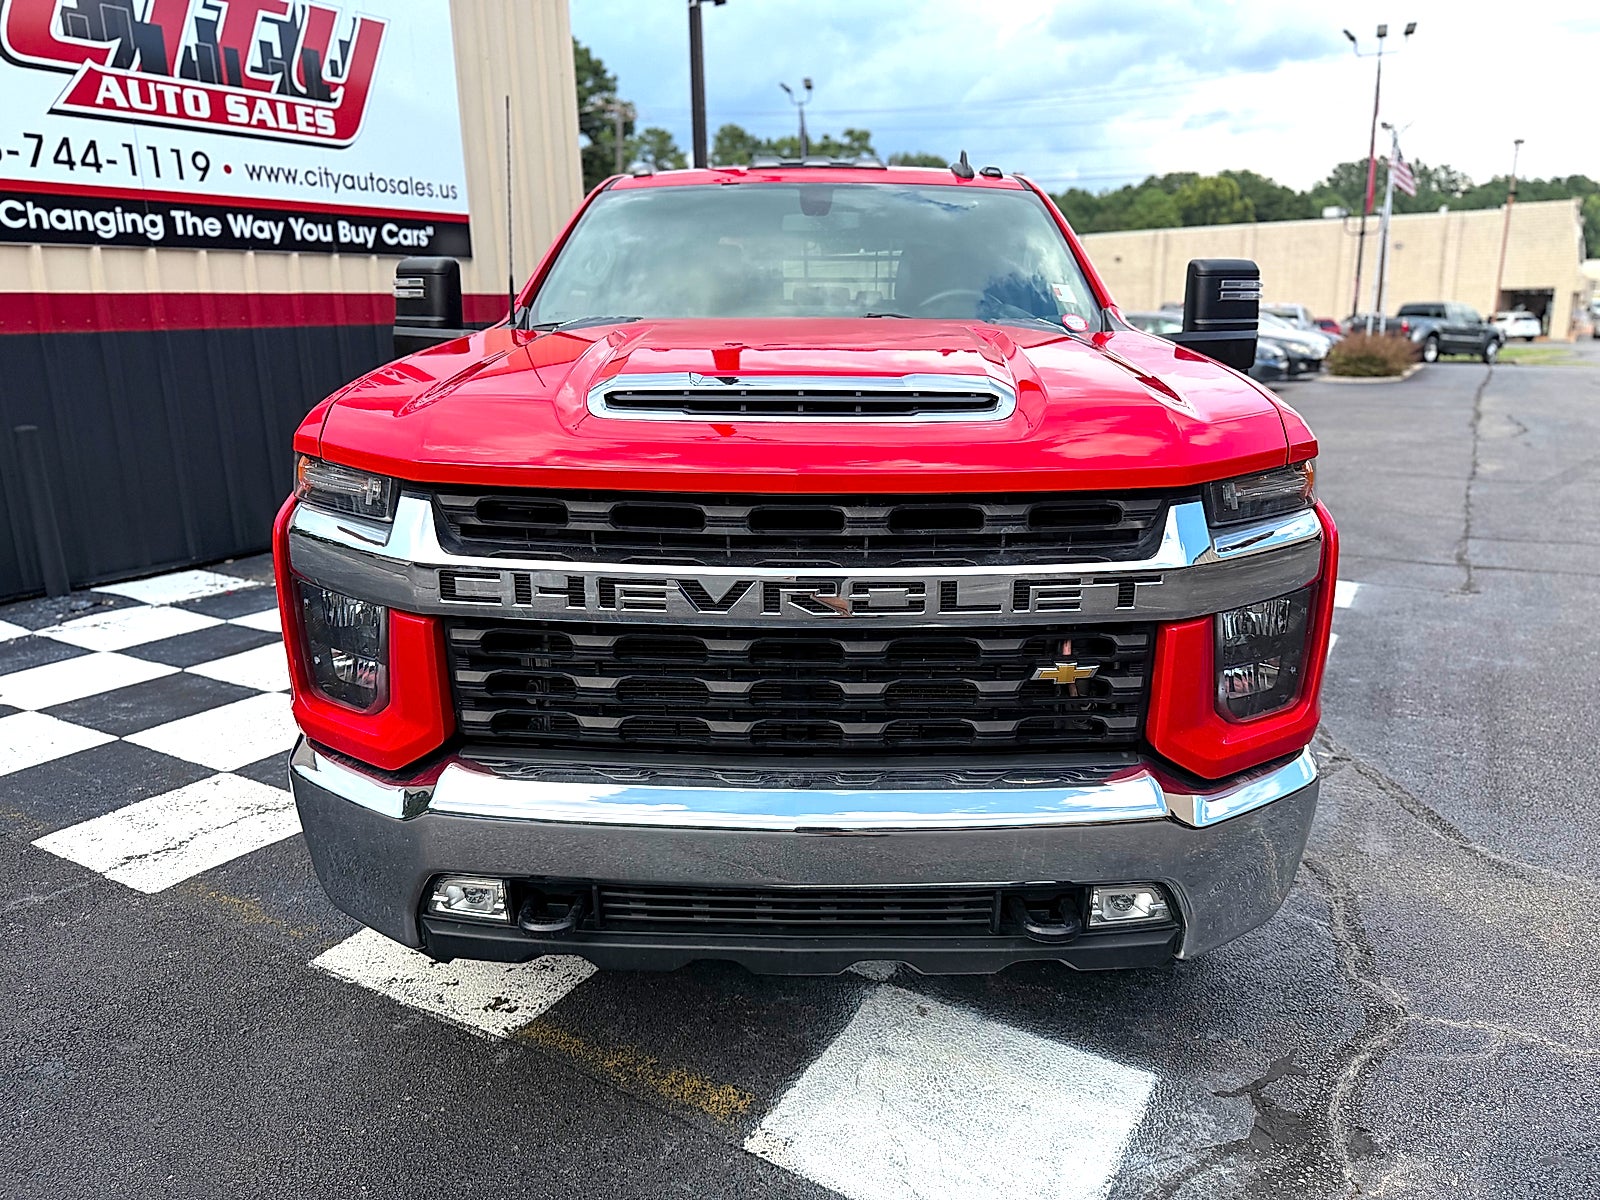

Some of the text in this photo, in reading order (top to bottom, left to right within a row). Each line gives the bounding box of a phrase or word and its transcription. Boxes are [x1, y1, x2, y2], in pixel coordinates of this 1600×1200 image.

[94, 74, 337, 136] AUTO SALES
[0, 132, 458, 200] -744-1119 www.cityautosales.us
[0, 200, 165, 241] Changing
[170, 210, 222, 238] The
[226, 213, 284, 245] Way
[287, 217, 333, 243] You
[337, 220, 377, 249] Buy
[438, 568, 1165, 616] CHEVROLET
